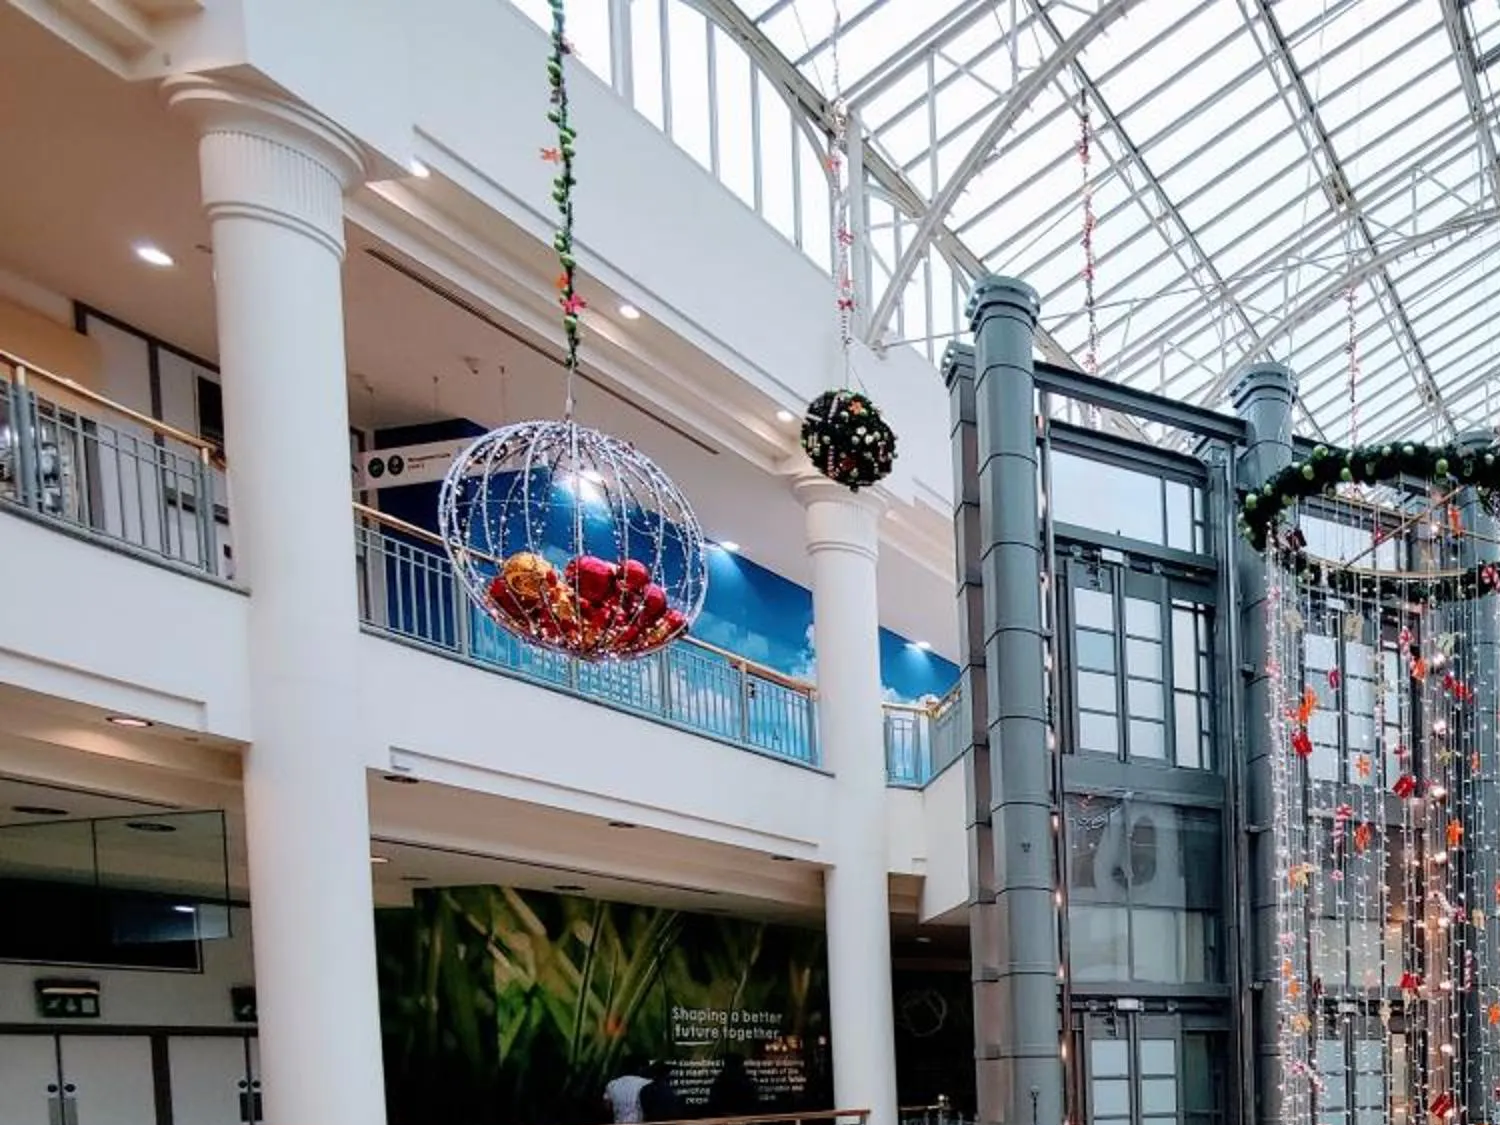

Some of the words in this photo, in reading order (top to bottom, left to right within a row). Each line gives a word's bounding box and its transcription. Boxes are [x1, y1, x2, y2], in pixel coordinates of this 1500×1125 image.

[672, 1006, 727, 1025] Shaping
[731, 1012, 739, 1021] a
[743, 1010, 782, 1024] better
[675, 1024, 719, 1038] future
